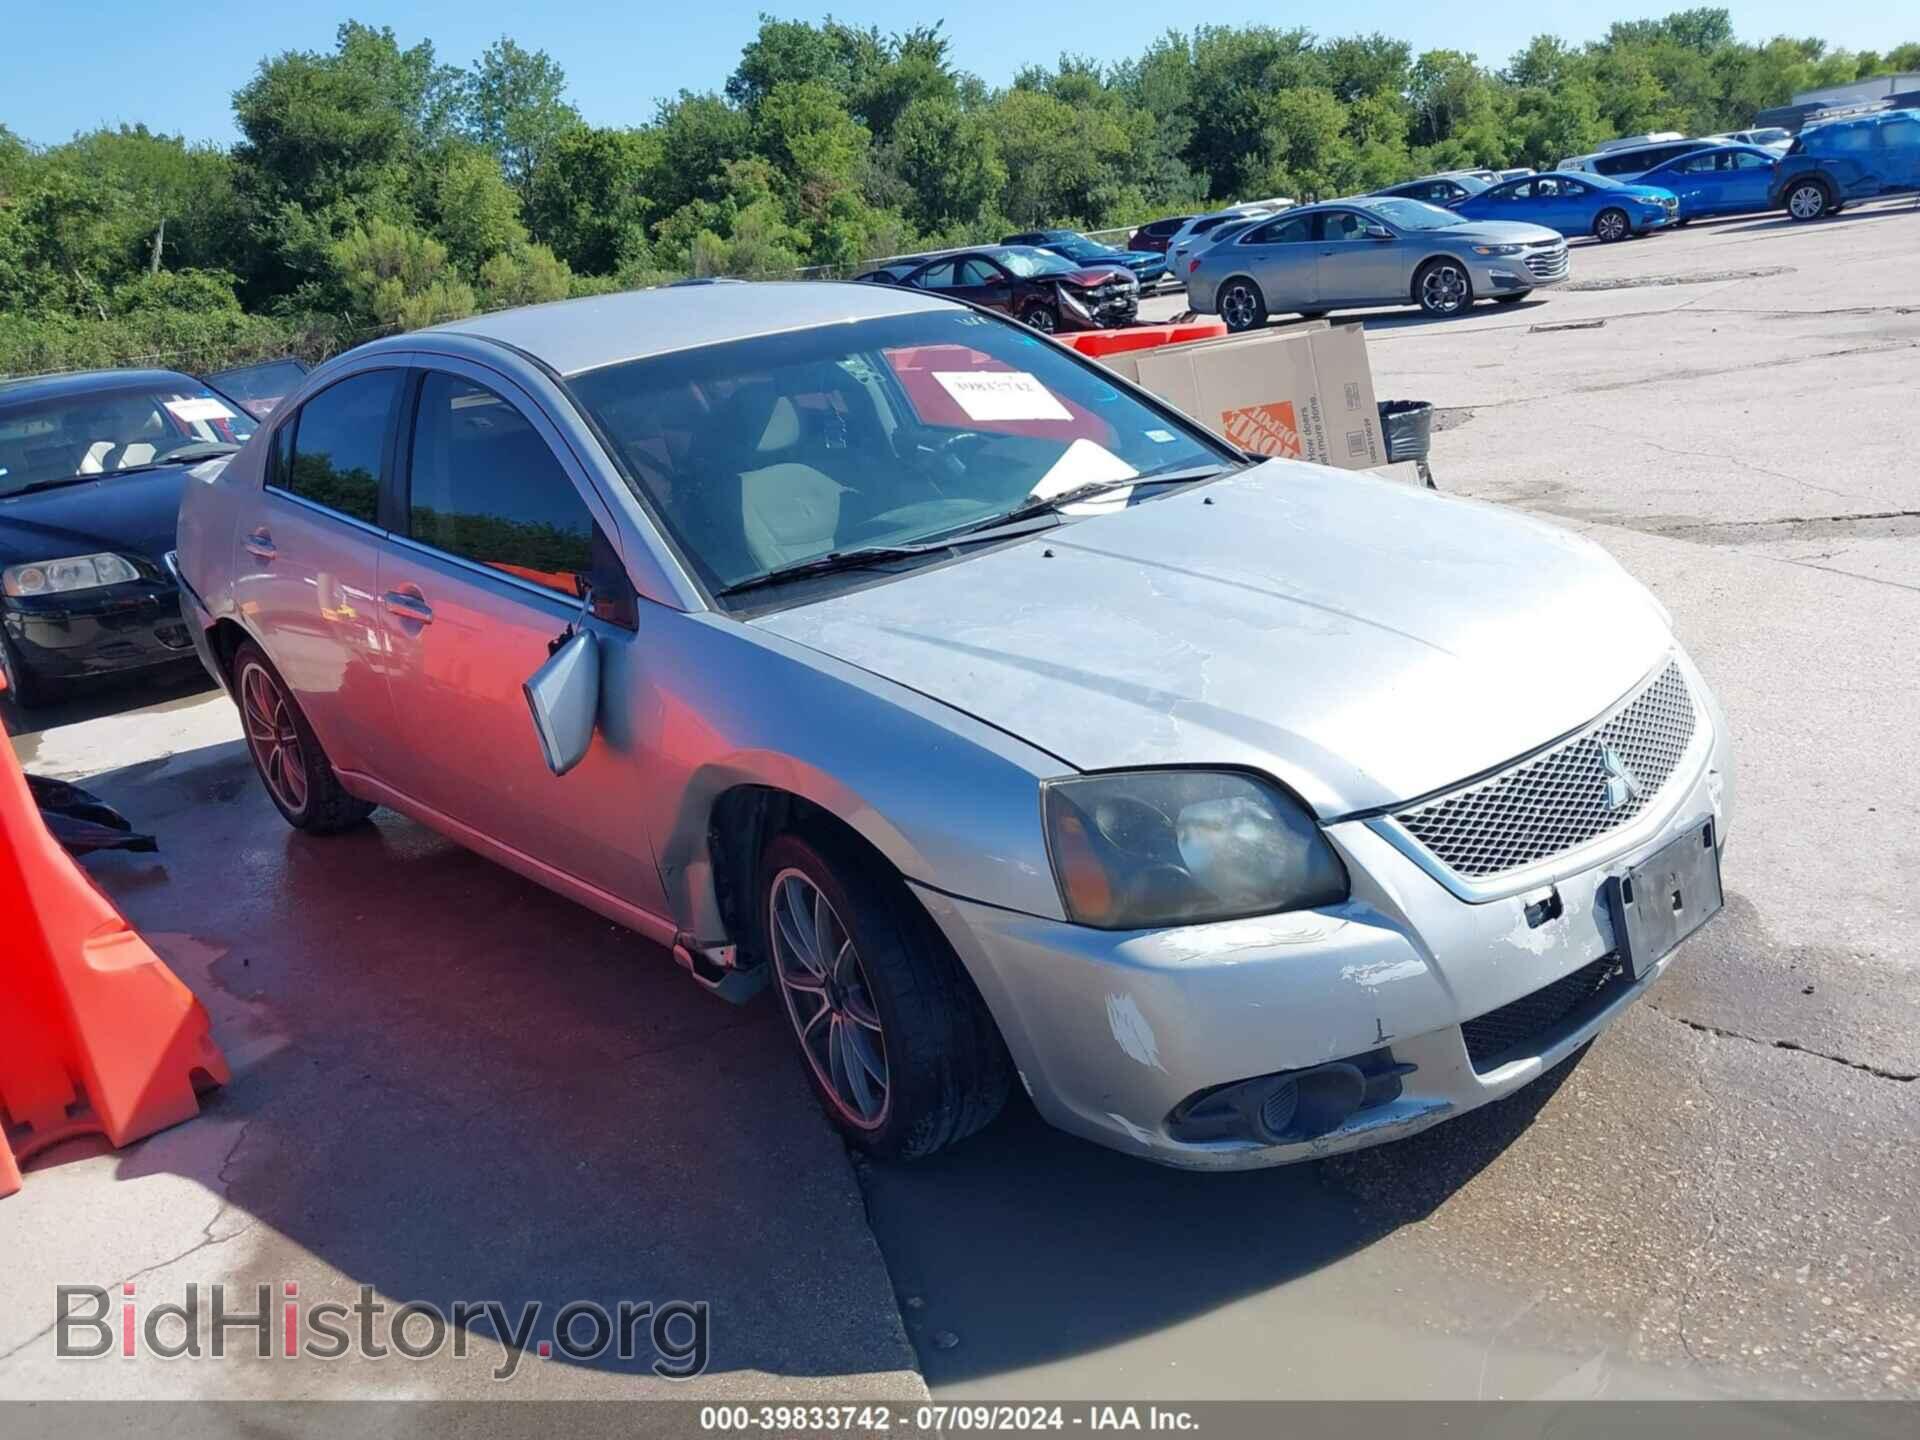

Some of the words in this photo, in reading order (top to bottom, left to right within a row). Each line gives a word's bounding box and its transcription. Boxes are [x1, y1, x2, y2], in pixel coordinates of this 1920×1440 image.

[1301, 407, 1312, 436] doers
[1309, 392, 1321, 423] done.
[1249, 407, 1297, 442] DEPOT
[1315, 424, 1325, 450] more
[1306, 438, 1316, 460] How
